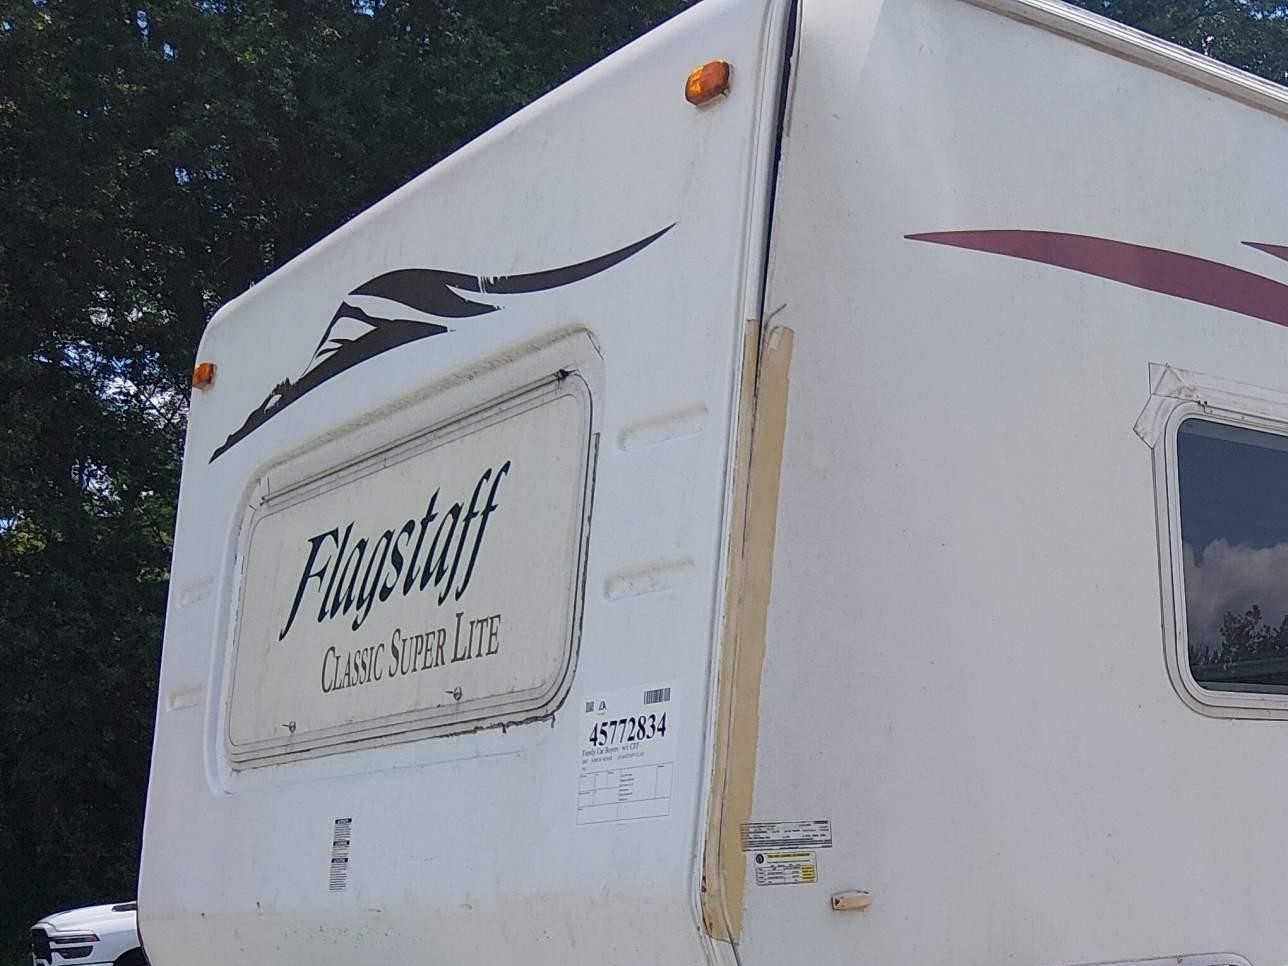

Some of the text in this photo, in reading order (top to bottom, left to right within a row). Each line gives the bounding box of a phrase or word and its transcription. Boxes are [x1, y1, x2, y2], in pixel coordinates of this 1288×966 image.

[279, 460, 511, 641] Flagstaff
[321, 611, 501, 693] CLASSIC SUPER LITE
[589, 712, 667, 746] 45772834
